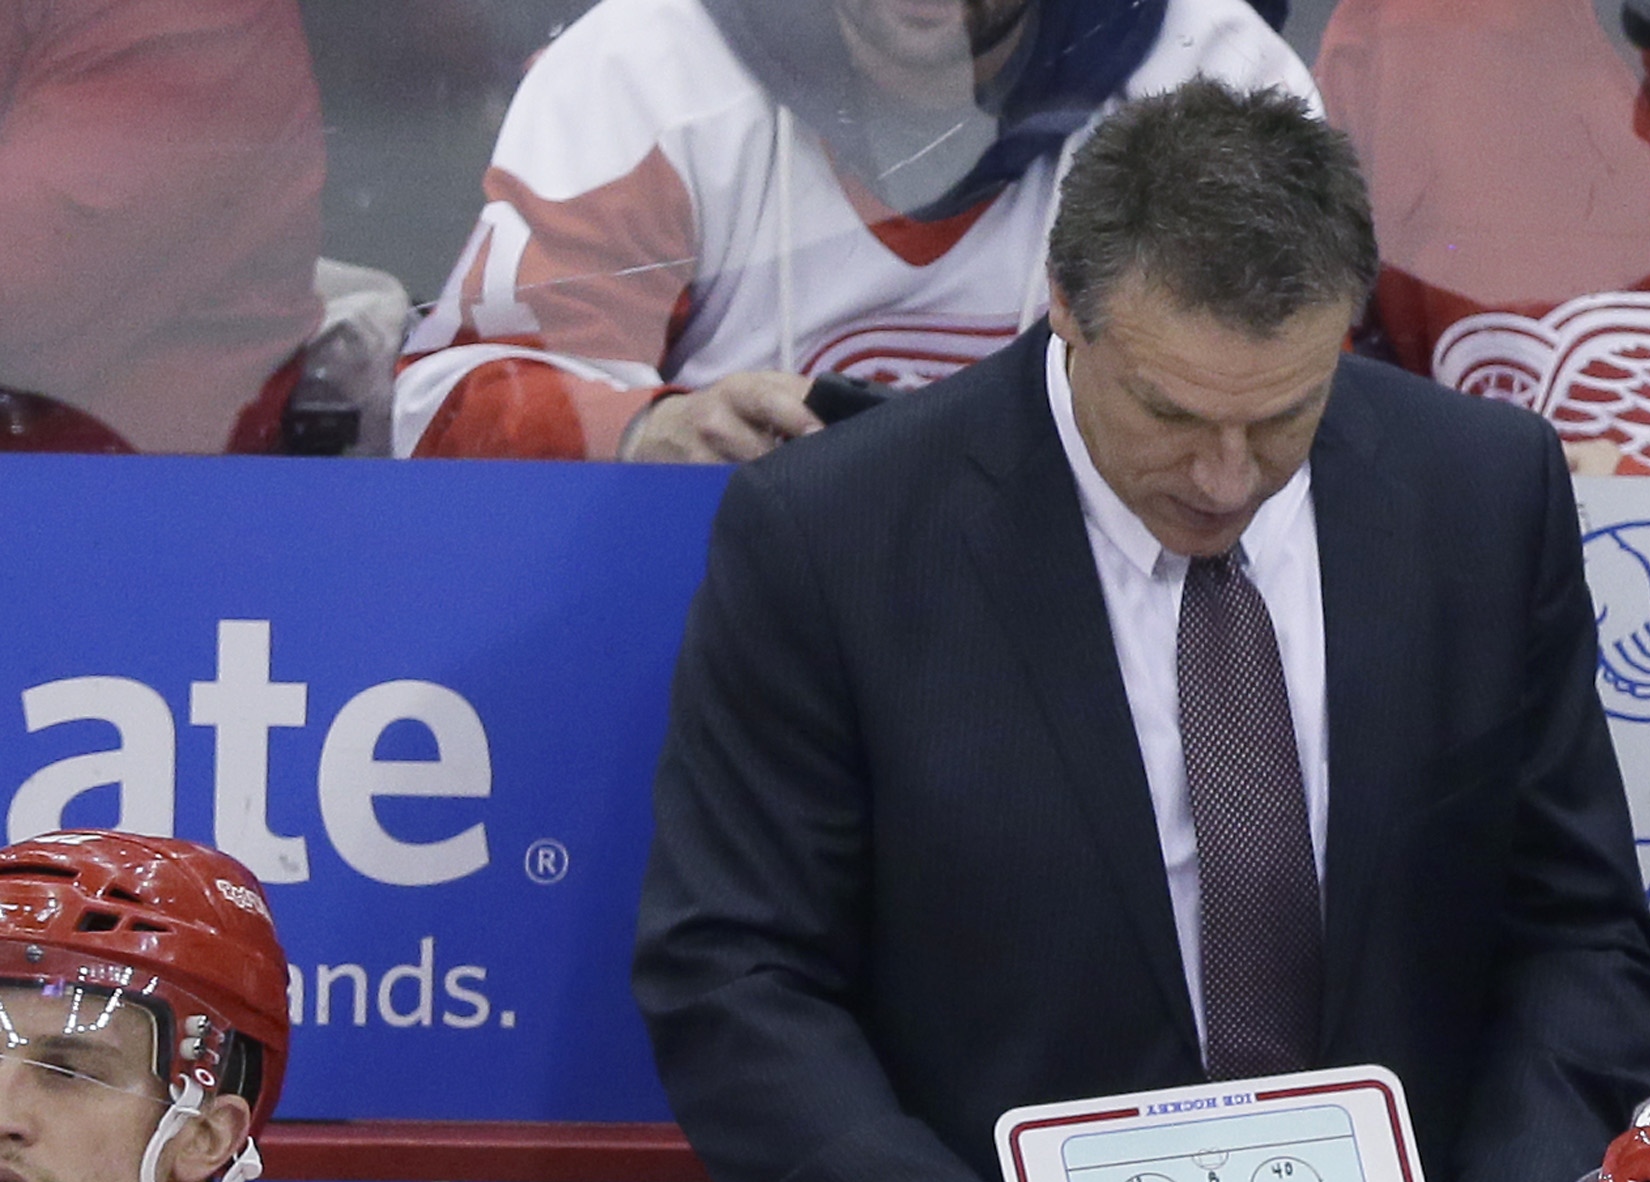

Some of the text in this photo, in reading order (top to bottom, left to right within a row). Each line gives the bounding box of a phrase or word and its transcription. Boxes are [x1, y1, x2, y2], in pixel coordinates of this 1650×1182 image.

[1146, 1093, 1253, 1117] ICE HOCKEY
[1271, 1162, 1294, 1179] 40
